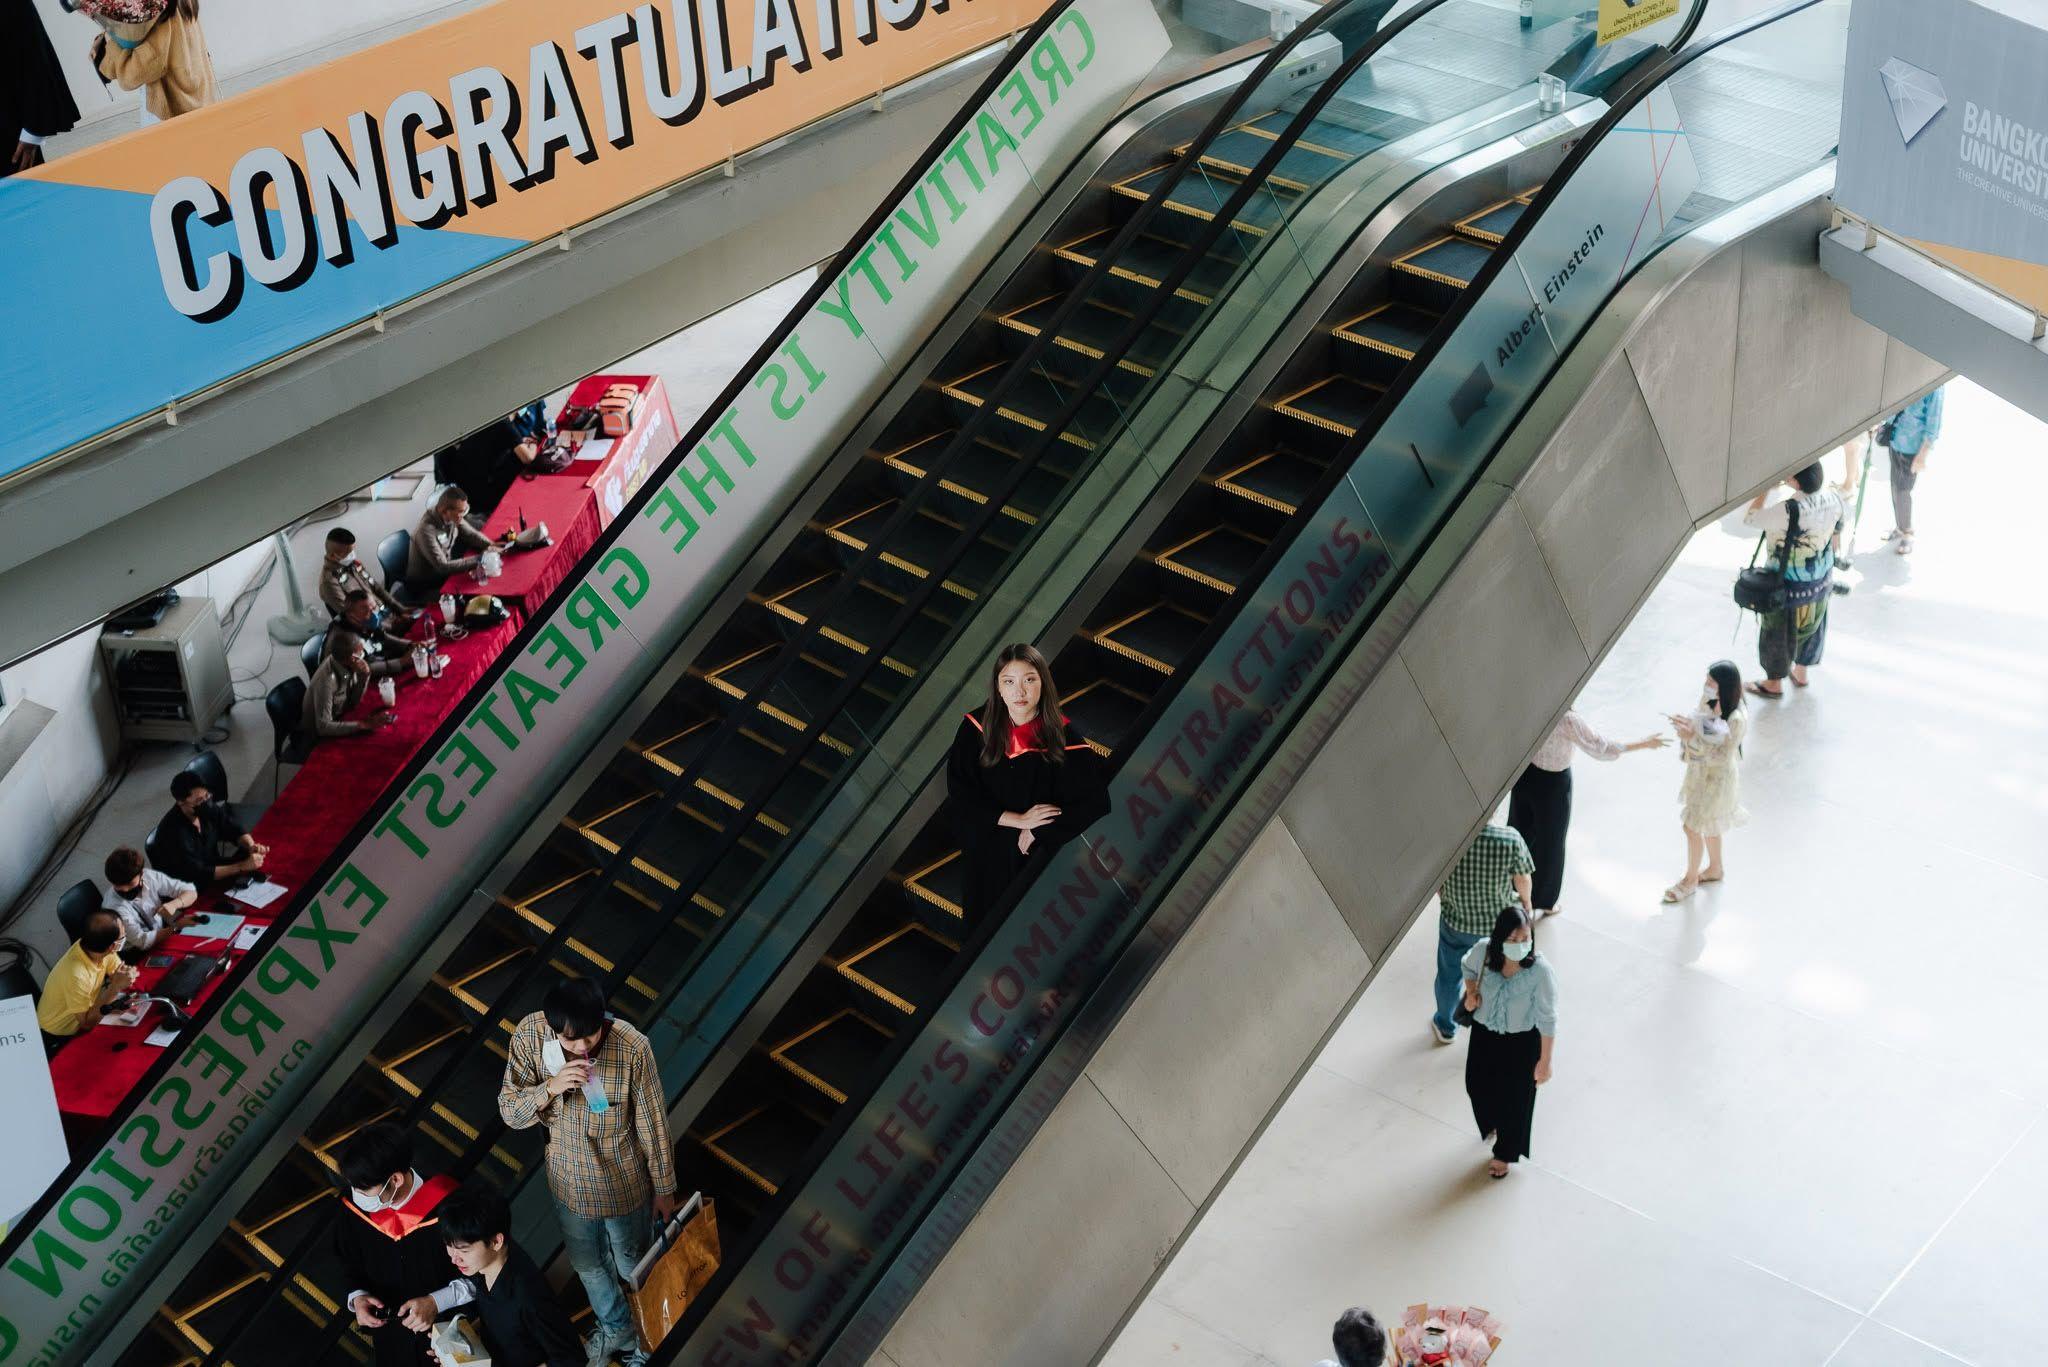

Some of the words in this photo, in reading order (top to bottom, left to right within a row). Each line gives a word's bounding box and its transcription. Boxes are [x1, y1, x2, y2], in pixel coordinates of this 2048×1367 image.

[150, 0, 974, 322] CONGRATULA
[1957, 167, 1974, 184] THE
[1974, 176, 2012, 204] CREATIVE
[1963, 101, 2048, 170] BANGKO
[1496, 302, 1544, 367] Albert
[1543, 222, 1604, 304] Einstein
[774, 1209, 836, 1292] OF
[834, 1039, 970, 1211] LIFE'S
[969, 835, 1124, 1037] COMING
[1124, 516, 1373, 841] ATTRACTIONS.
